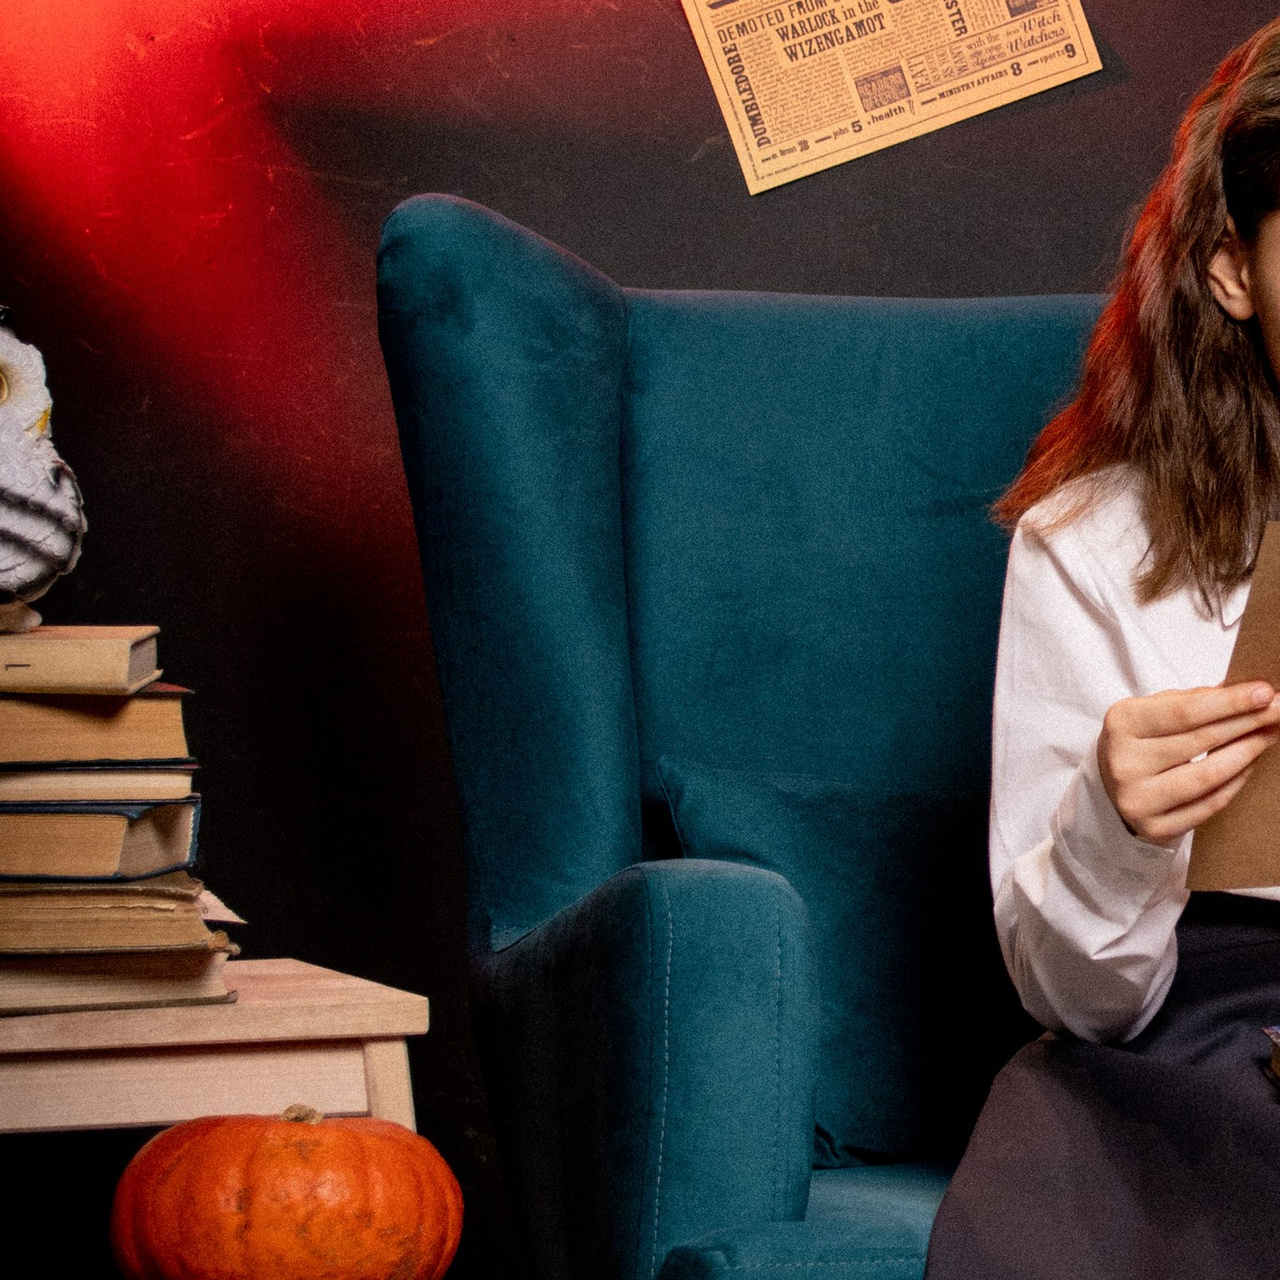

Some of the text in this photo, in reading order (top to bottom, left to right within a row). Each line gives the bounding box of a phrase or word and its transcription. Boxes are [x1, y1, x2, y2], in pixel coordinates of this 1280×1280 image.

[715, 6, 786, 45] DEMOTED
[775, 6, 841, 44] WARLOCK
[840, 1, 857, 20] in
[782, 11, 888, 64] WIZENGAMOT
[1005, 21, 1066, 54] Watchers
[1017, 7, 1062, 35] Witch
[1062, 41, 1078, 59] 9
[721, 41, 772, 149] DUMBLEDORE
[937, 60, 1024, 100] MINISTRY AFFAIRS 8
[849, 118, 864, 134] 5
